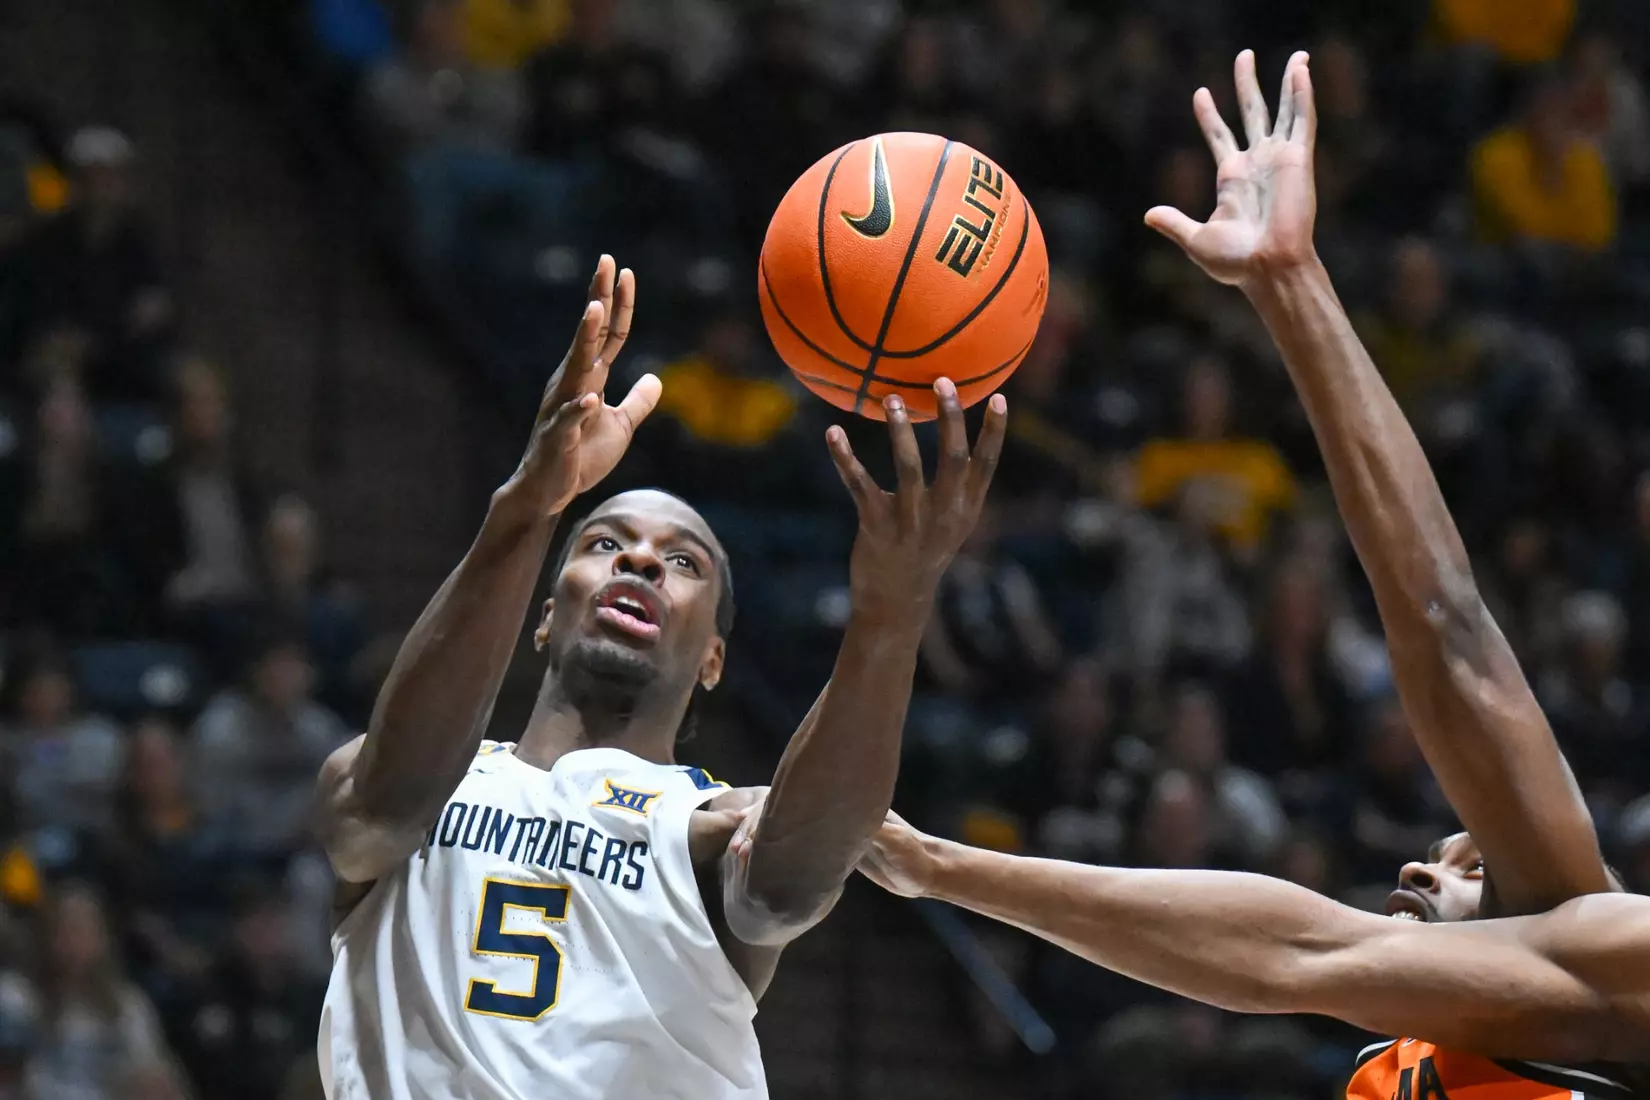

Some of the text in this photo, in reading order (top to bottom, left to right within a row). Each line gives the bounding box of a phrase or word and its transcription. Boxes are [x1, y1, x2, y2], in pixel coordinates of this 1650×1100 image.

[935, 155, 1004, 279] ELITE
[594, 779, 661, 816] XII
[464, 876, 572, 1022] 5
